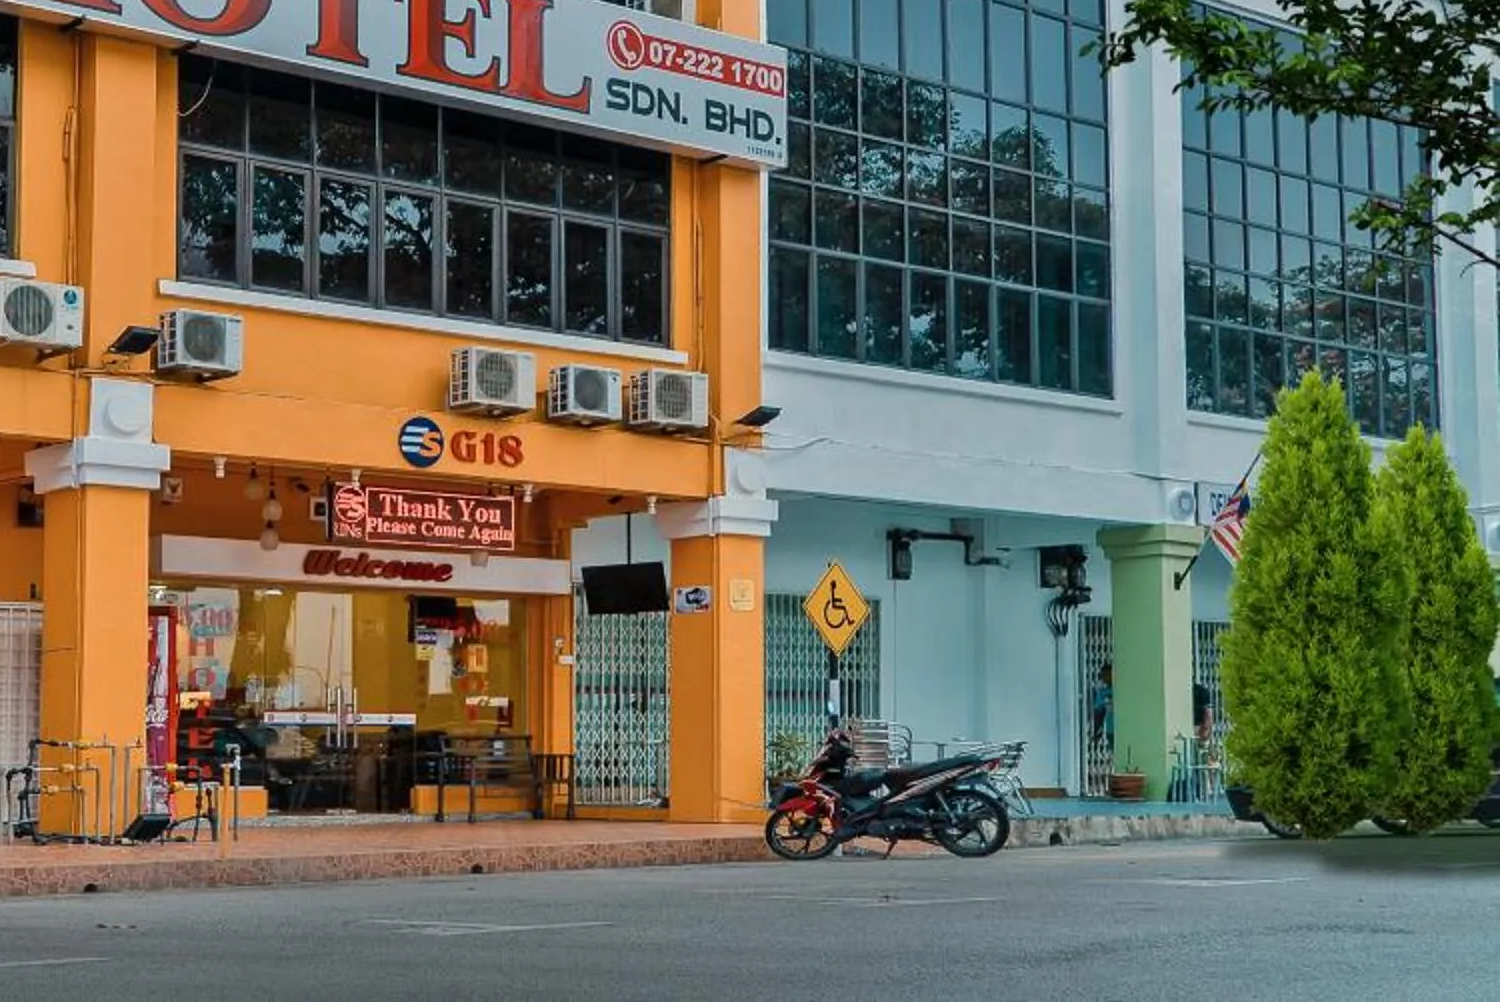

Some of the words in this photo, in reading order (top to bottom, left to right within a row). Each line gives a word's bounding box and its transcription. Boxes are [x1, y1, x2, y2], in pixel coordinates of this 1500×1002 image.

[648, 40, 724, 79] 07-222
[730, 62, 783, 91] 1700
[605, 77, 689, 125] SDN.
[705, 98, 784, 145] BHD.
[450, 429, 524, 468] G18
[379, 493, 453, 521] Thank
[457, 499, 502, 524] You
[366, 517, 417, 535] Please
[421, 521, 466, 539] Come
[469, 525, 514, 545] Again
[303, 549, 454, 582] Welcome
